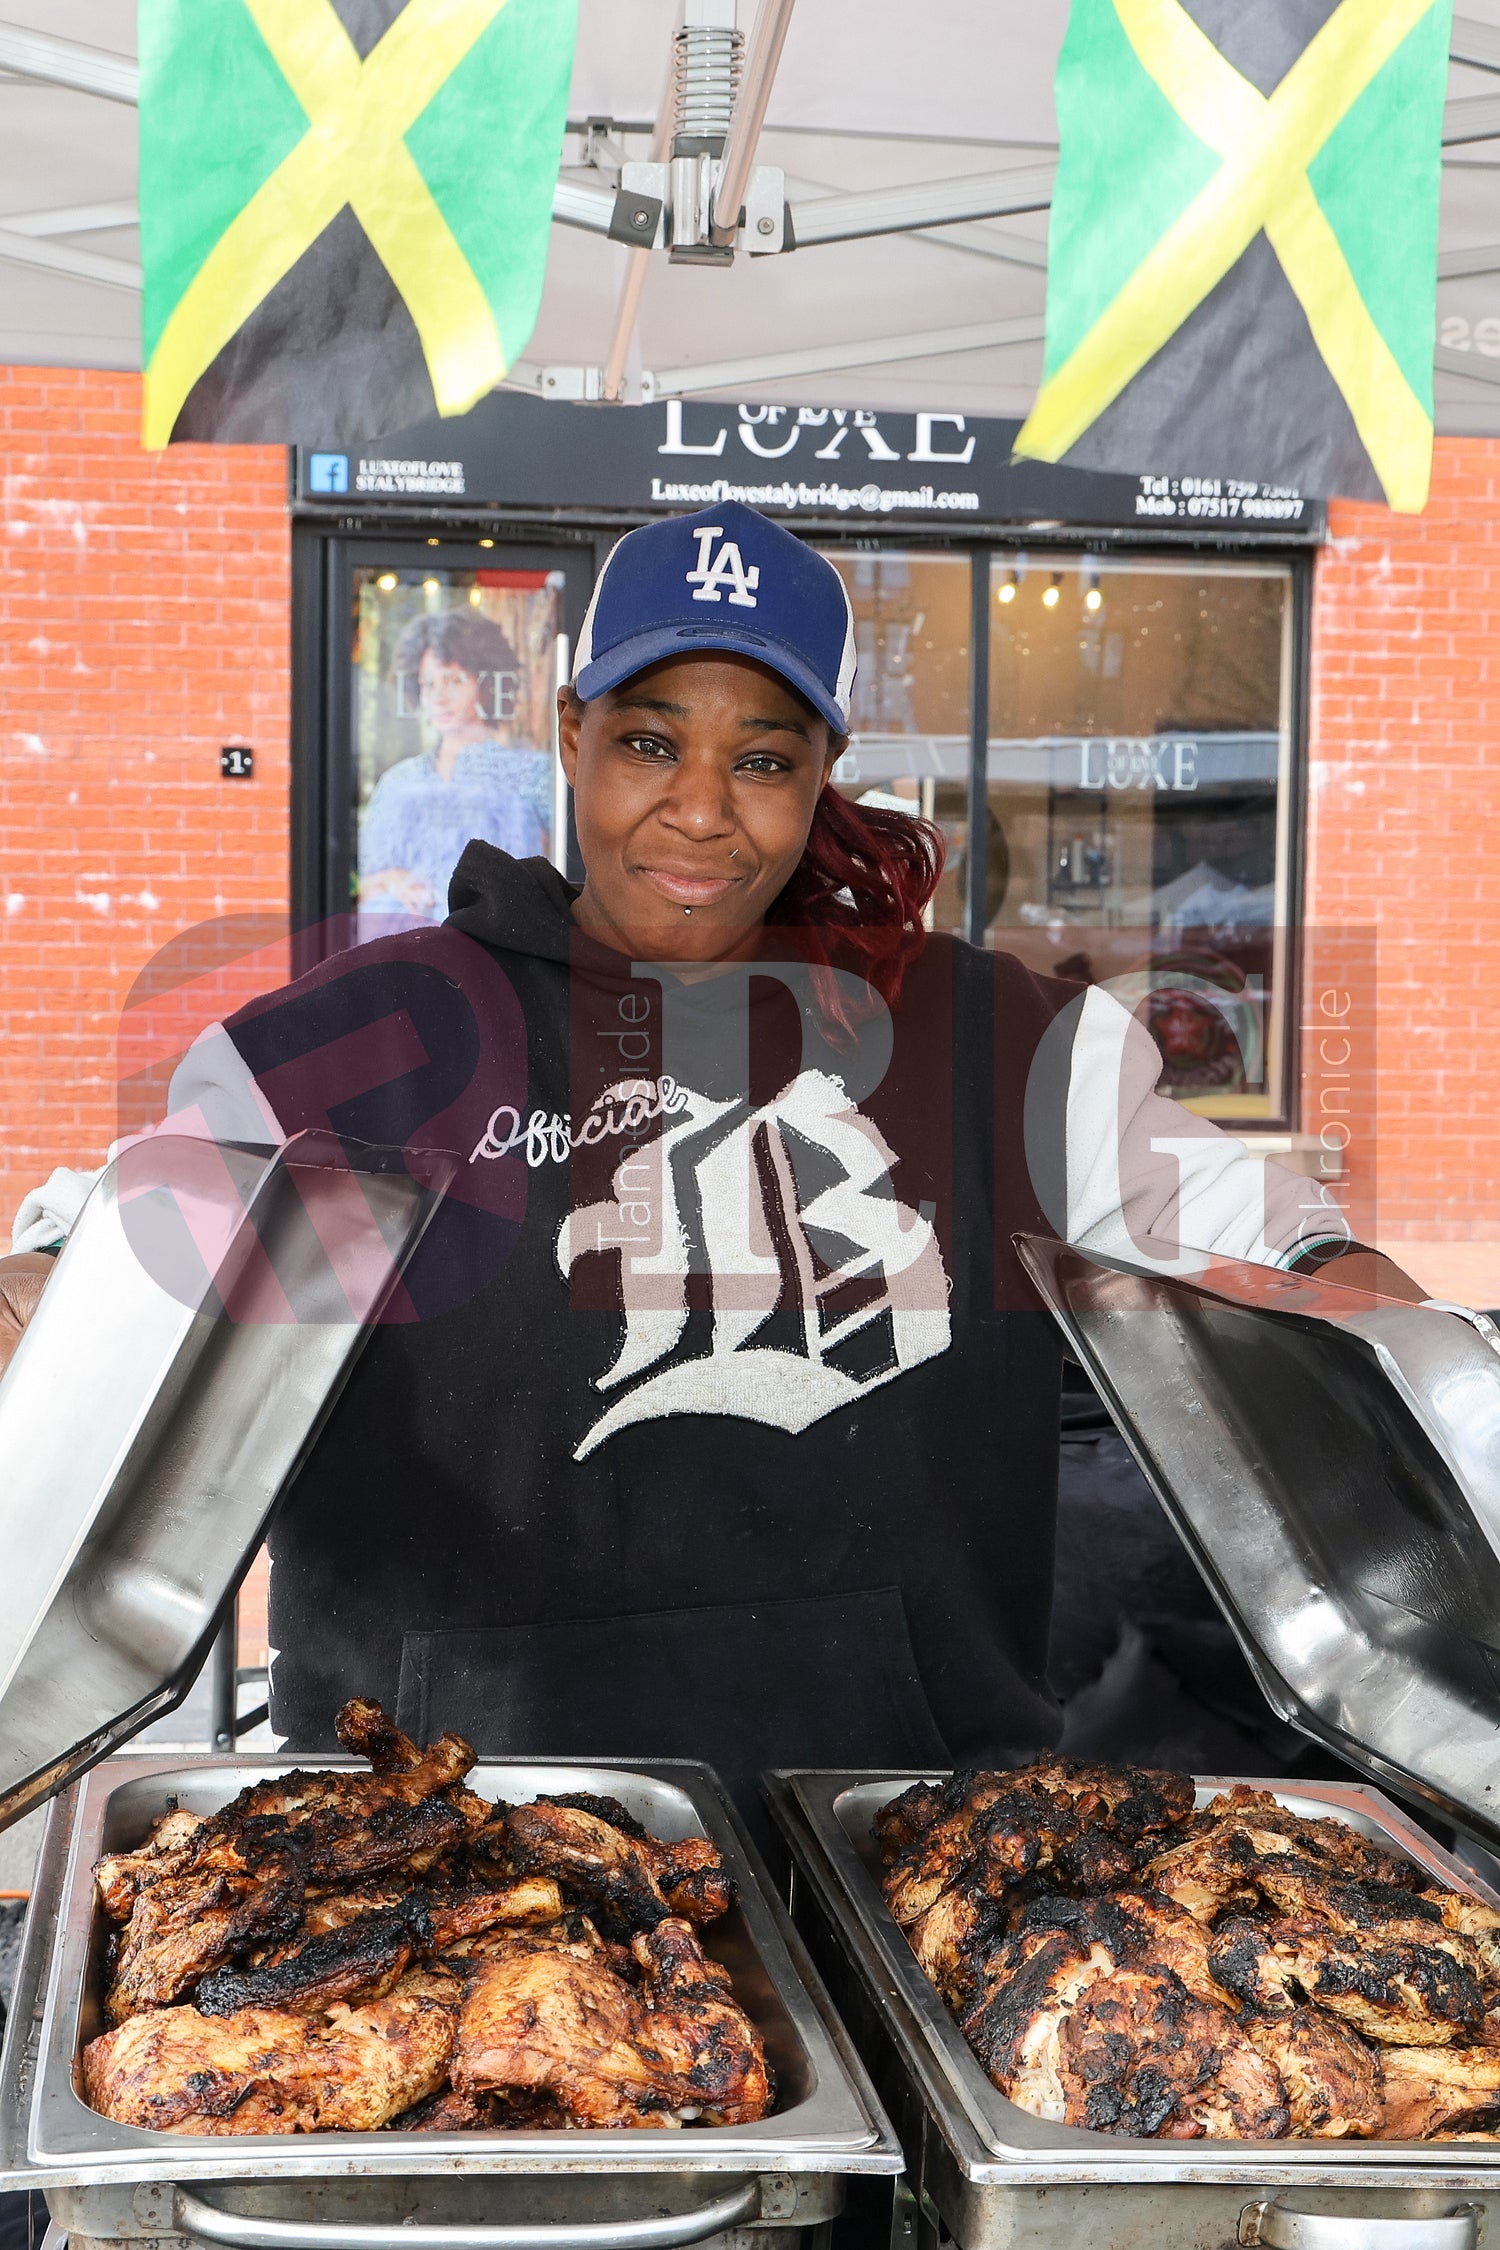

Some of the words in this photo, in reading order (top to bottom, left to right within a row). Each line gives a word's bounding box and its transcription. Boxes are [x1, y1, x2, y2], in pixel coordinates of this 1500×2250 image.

[686, 527, 760, 608] LA
[229, 750, 245, 774] 1
[1080, 740, 1199, 791] LUXE
[469, 1075, 688, 1168] Official
